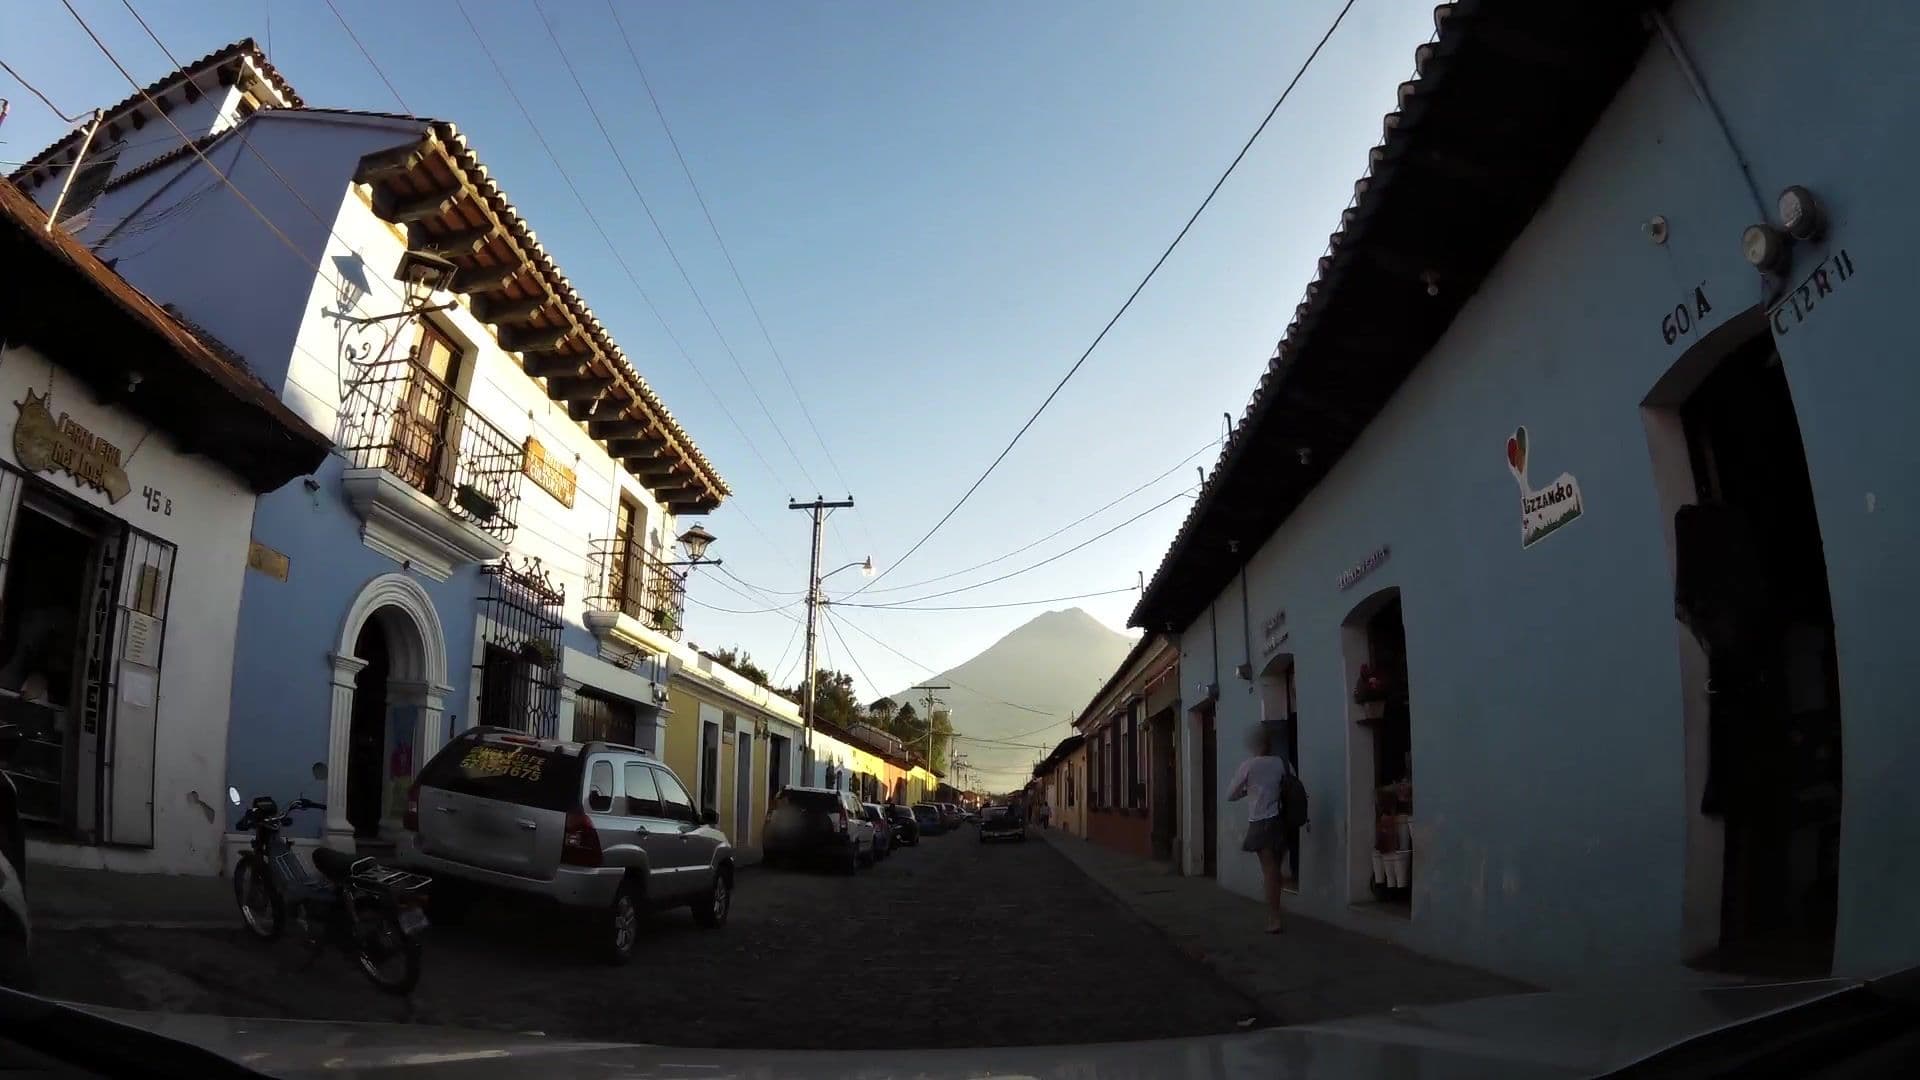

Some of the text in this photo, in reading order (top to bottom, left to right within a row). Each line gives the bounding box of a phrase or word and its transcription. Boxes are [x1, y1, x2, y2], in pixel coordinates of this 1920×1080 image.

[1662, 303, 1690, 345] 60
[142, 485, 172, 516] 45 B
